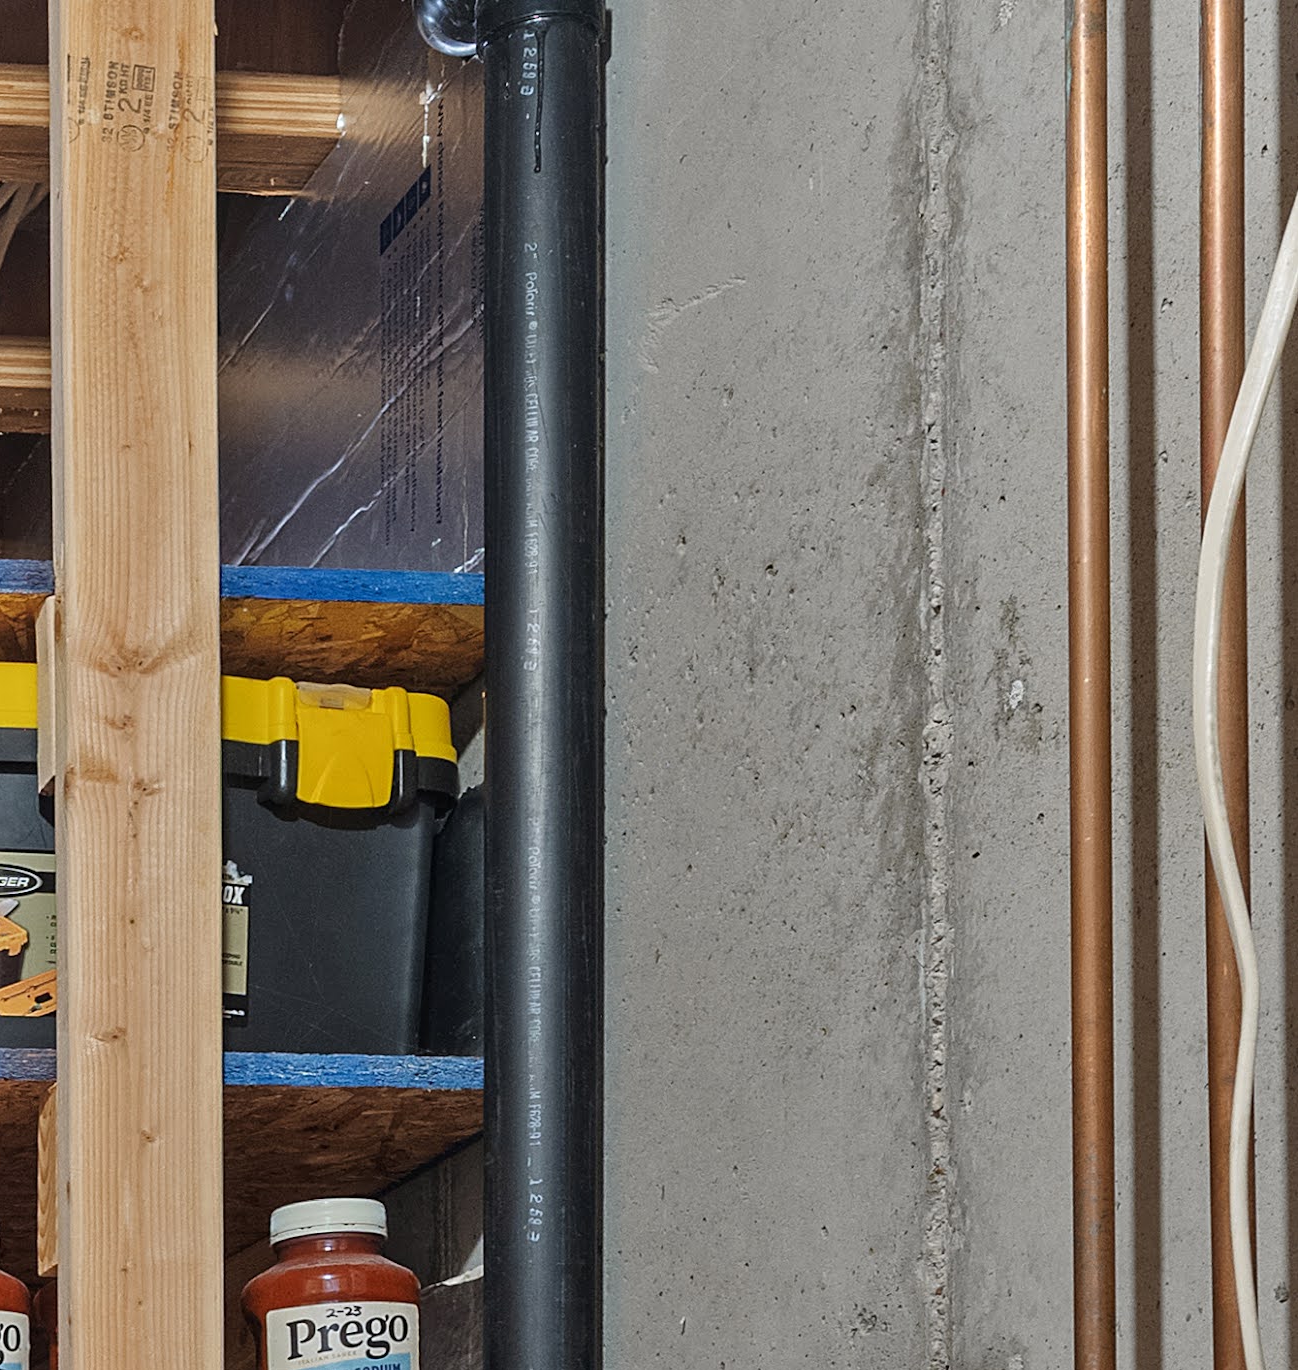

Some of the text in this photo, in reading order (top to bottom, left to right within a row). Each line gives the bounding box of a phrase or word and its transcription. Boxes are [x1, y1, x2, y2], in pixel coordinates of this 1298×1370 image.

[118, 98, 141, 113] 2
[326, 1305, 362, 1318] 2-23
[286, 1314, 409, 1360] Prego
